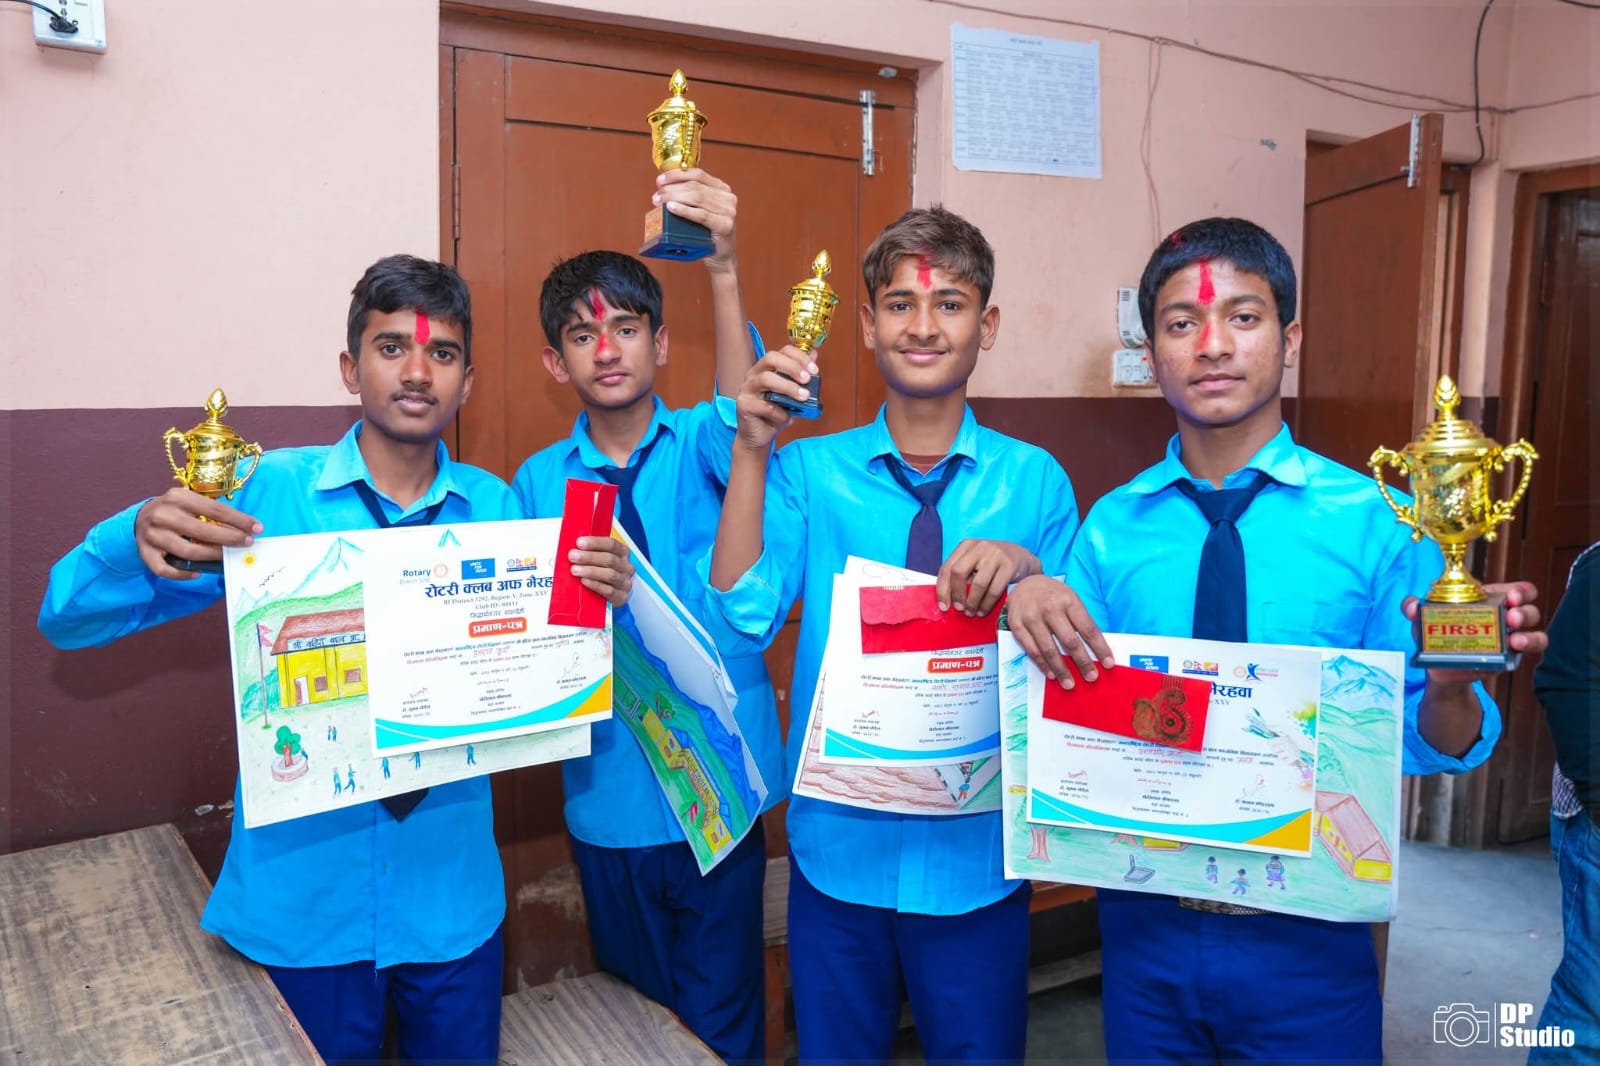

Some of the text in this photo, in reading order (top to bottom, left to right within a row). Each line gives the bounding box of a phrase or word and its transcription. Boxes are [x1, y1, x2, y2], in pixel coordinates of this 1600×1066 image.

[403, 568, 431, 578] Rotary
[424, 574, 552, 598] रोटरी क्लब अफ भैरह
[473, 621, 524, 634] प्रमाण-पत्र
[1427, 624, 1494, 636] FIRST
[932, 659, 980, 670] प्रमाण-पत्र
